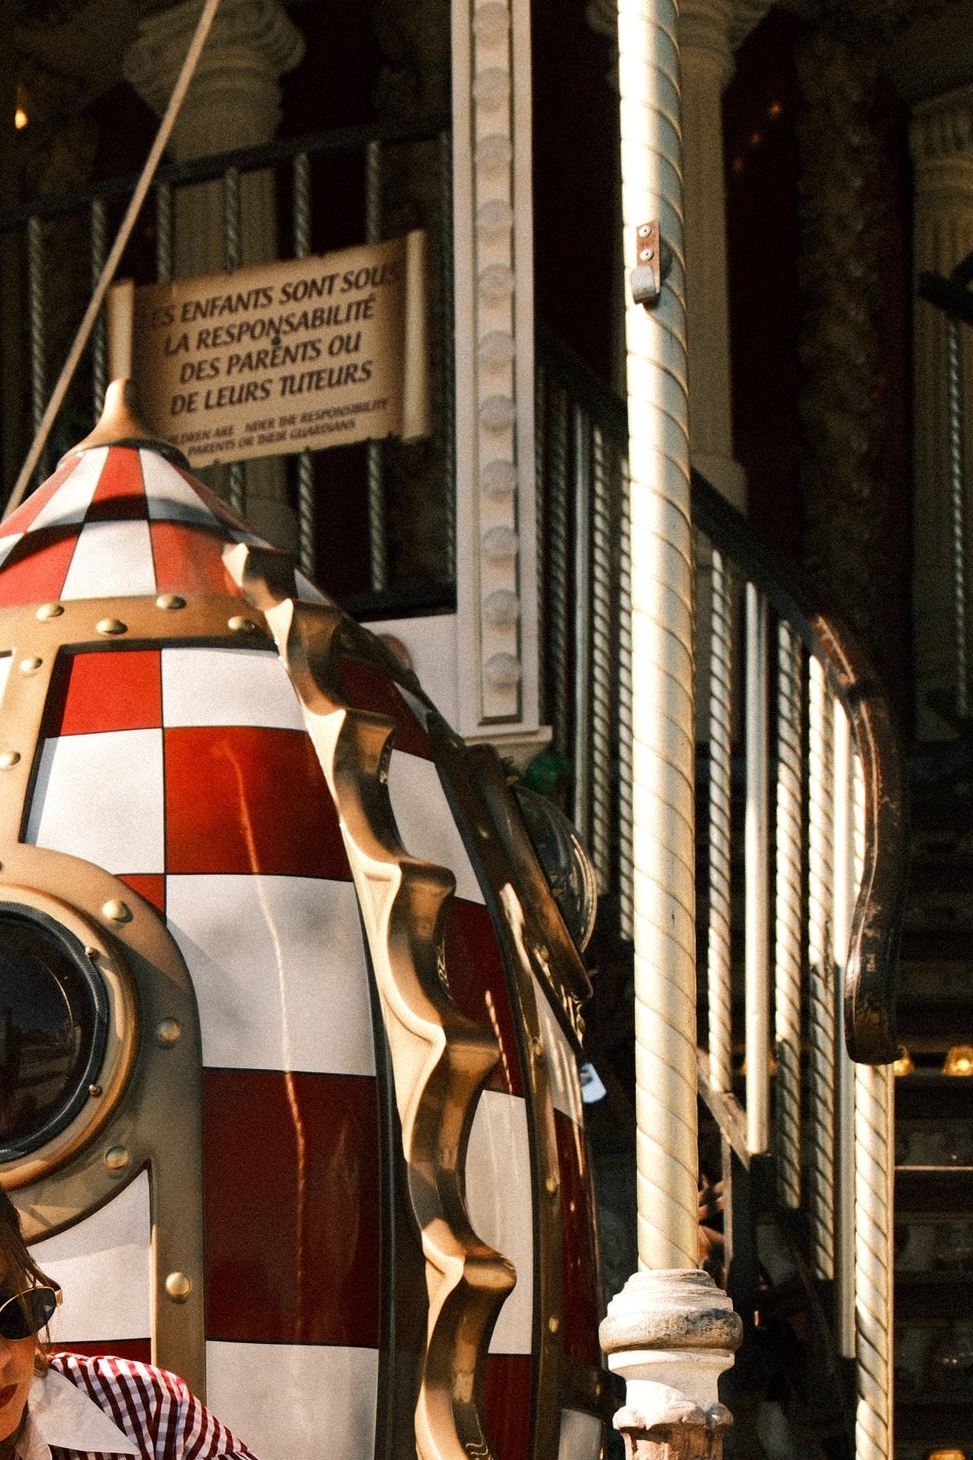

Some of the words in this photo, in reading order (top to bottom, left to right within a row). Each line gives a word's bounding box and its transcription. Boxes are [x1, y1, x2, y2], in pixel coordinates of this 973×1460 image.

[164, 331, 189, 356] LA
[195, 293, 376, 351] RESPONSABILITÉ
[180, 286, 273, 323] ENFANTS
[279, 272, 339, 305] SONT
[179, 357, 221, 385] DES
[227, 338, 321, 377] PARENTS
[329, 331, 362, 356] OU
[170, 391, 198, 416] DE
[204, 379, 272, 410] LEURS
[279, 359, 373, 397] TUTEURS
